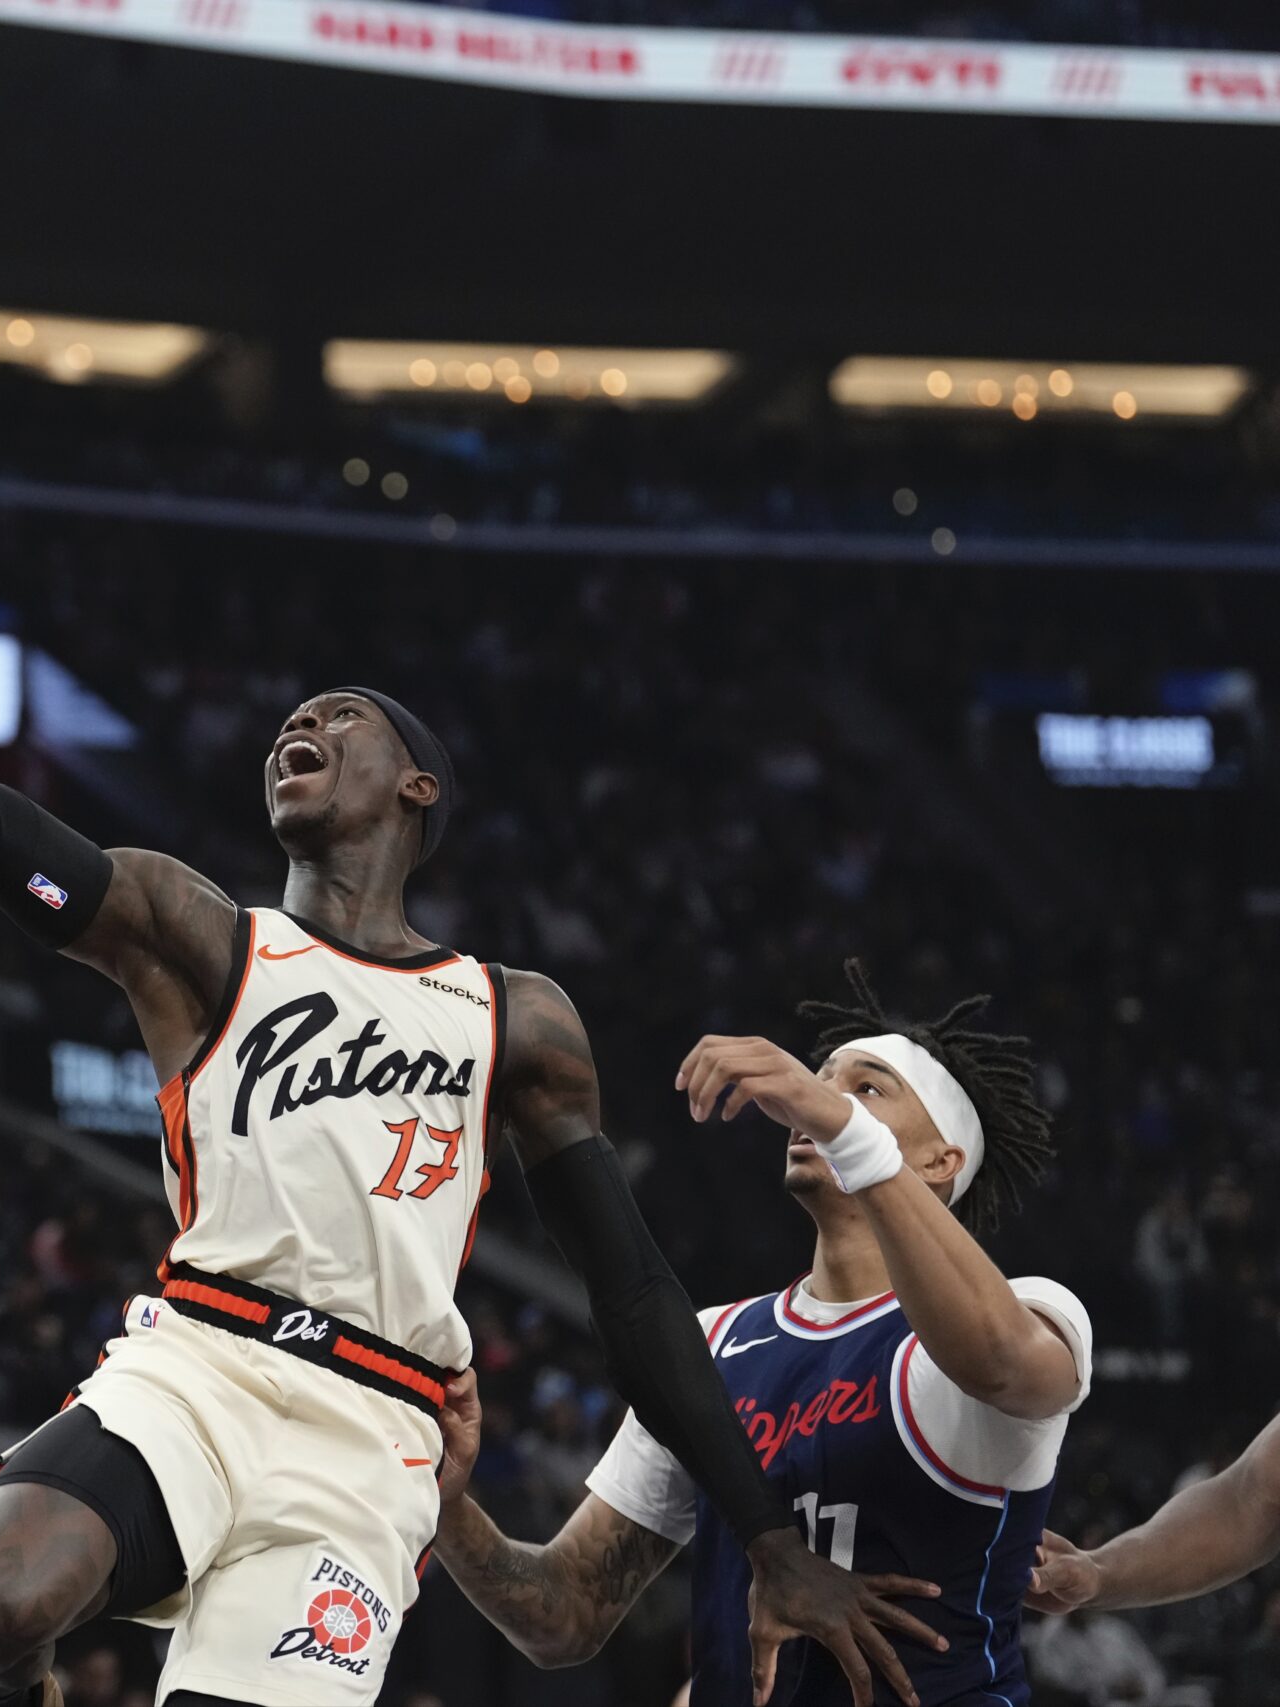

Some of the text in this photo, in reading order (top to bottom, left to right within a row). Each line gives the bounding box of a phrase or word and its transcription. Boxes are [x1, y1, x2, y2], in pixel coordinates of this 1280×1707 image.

[418, 976, 490, 1010] StockX
[231, 991, 476, 1137] Pistons
[369, 1117, 464, 1201] 17
[272, 1309, 329, 1342] Det
[311, 1557, 392, 1633] PISTONS
[270, 1626, 371, 1676] Detroit
